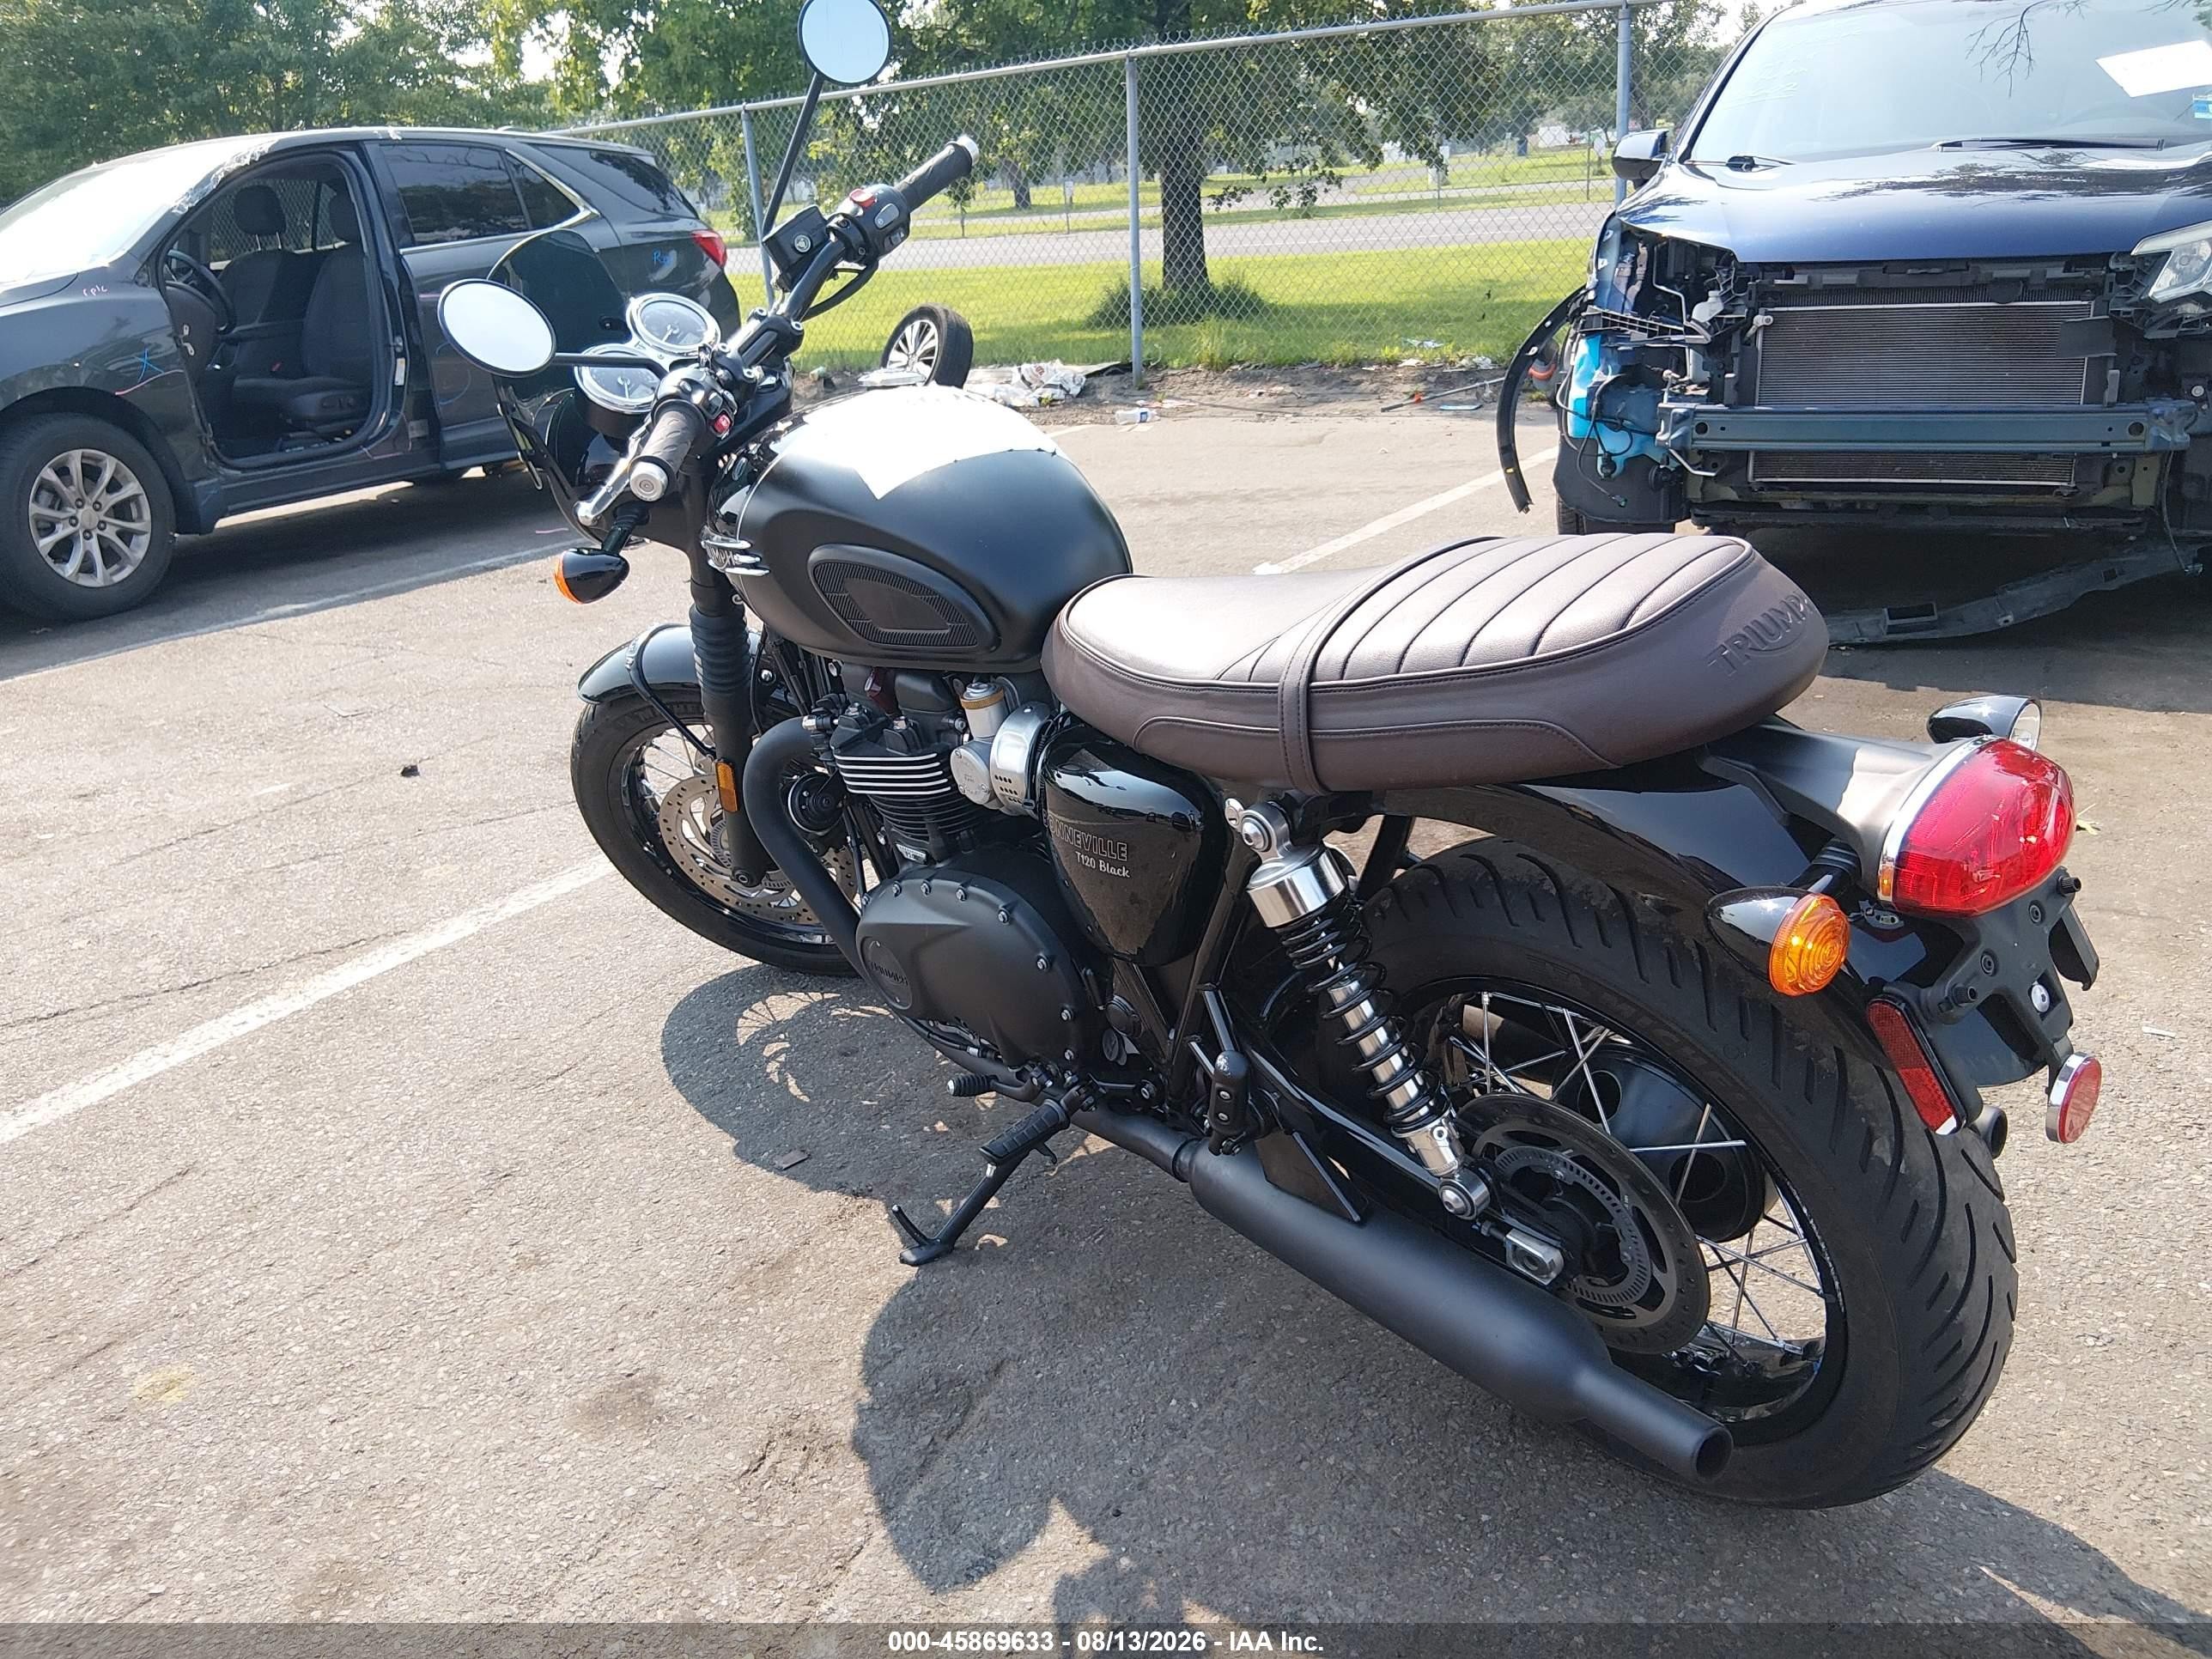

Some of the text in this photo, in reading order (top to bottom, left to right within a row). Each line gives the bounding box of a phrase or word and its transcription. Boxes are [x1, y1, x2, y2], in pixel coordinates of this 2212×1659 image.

[1042, 808, 1127, 861] BONNEVILLE
[1075, 851, 1131, 878] T120 Black
